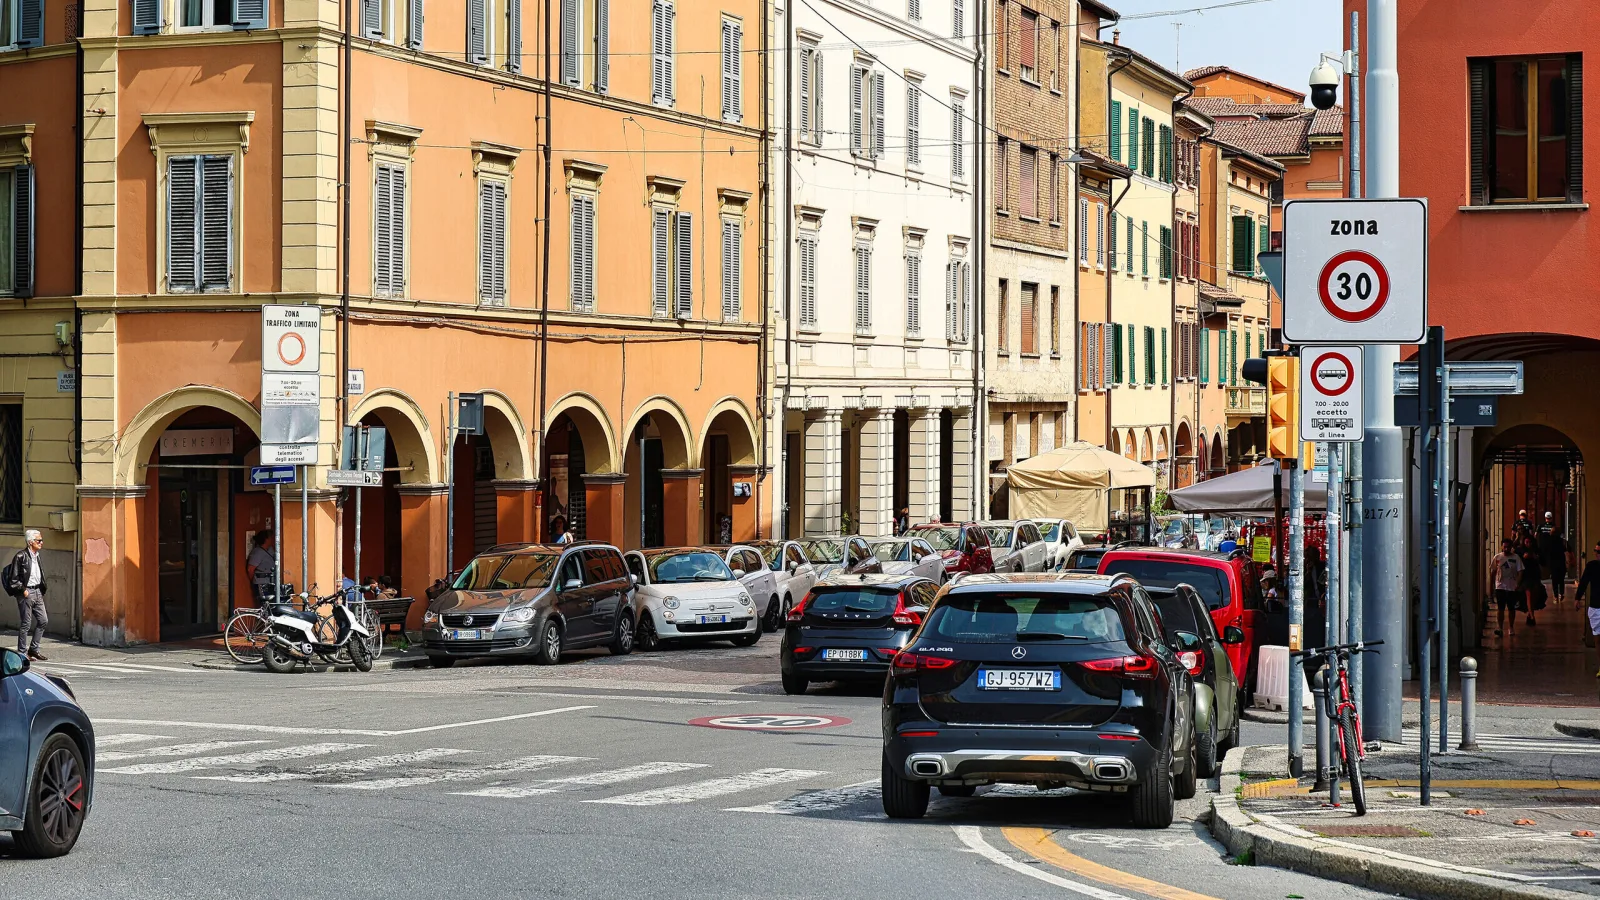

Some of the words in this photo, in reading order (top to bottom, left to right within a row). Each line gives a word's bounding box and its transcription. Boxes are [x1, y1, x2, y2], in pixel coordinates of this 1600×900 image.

[1330, 219, 1379, 236] zona
[1336, 272, 1372, 300] 30
[284, 310, 300, 318] ZONA
[266, 319, 292, 327] TRAFFICO
[294, 320, 318, 328] LIMITATO
[163, 436, 231, 449] CREMERIA
[1364, 507, 1399, 520] 217/2
[1009, 671, 1053, 687] 957WZ
[719, 716, 822, 726] 30
